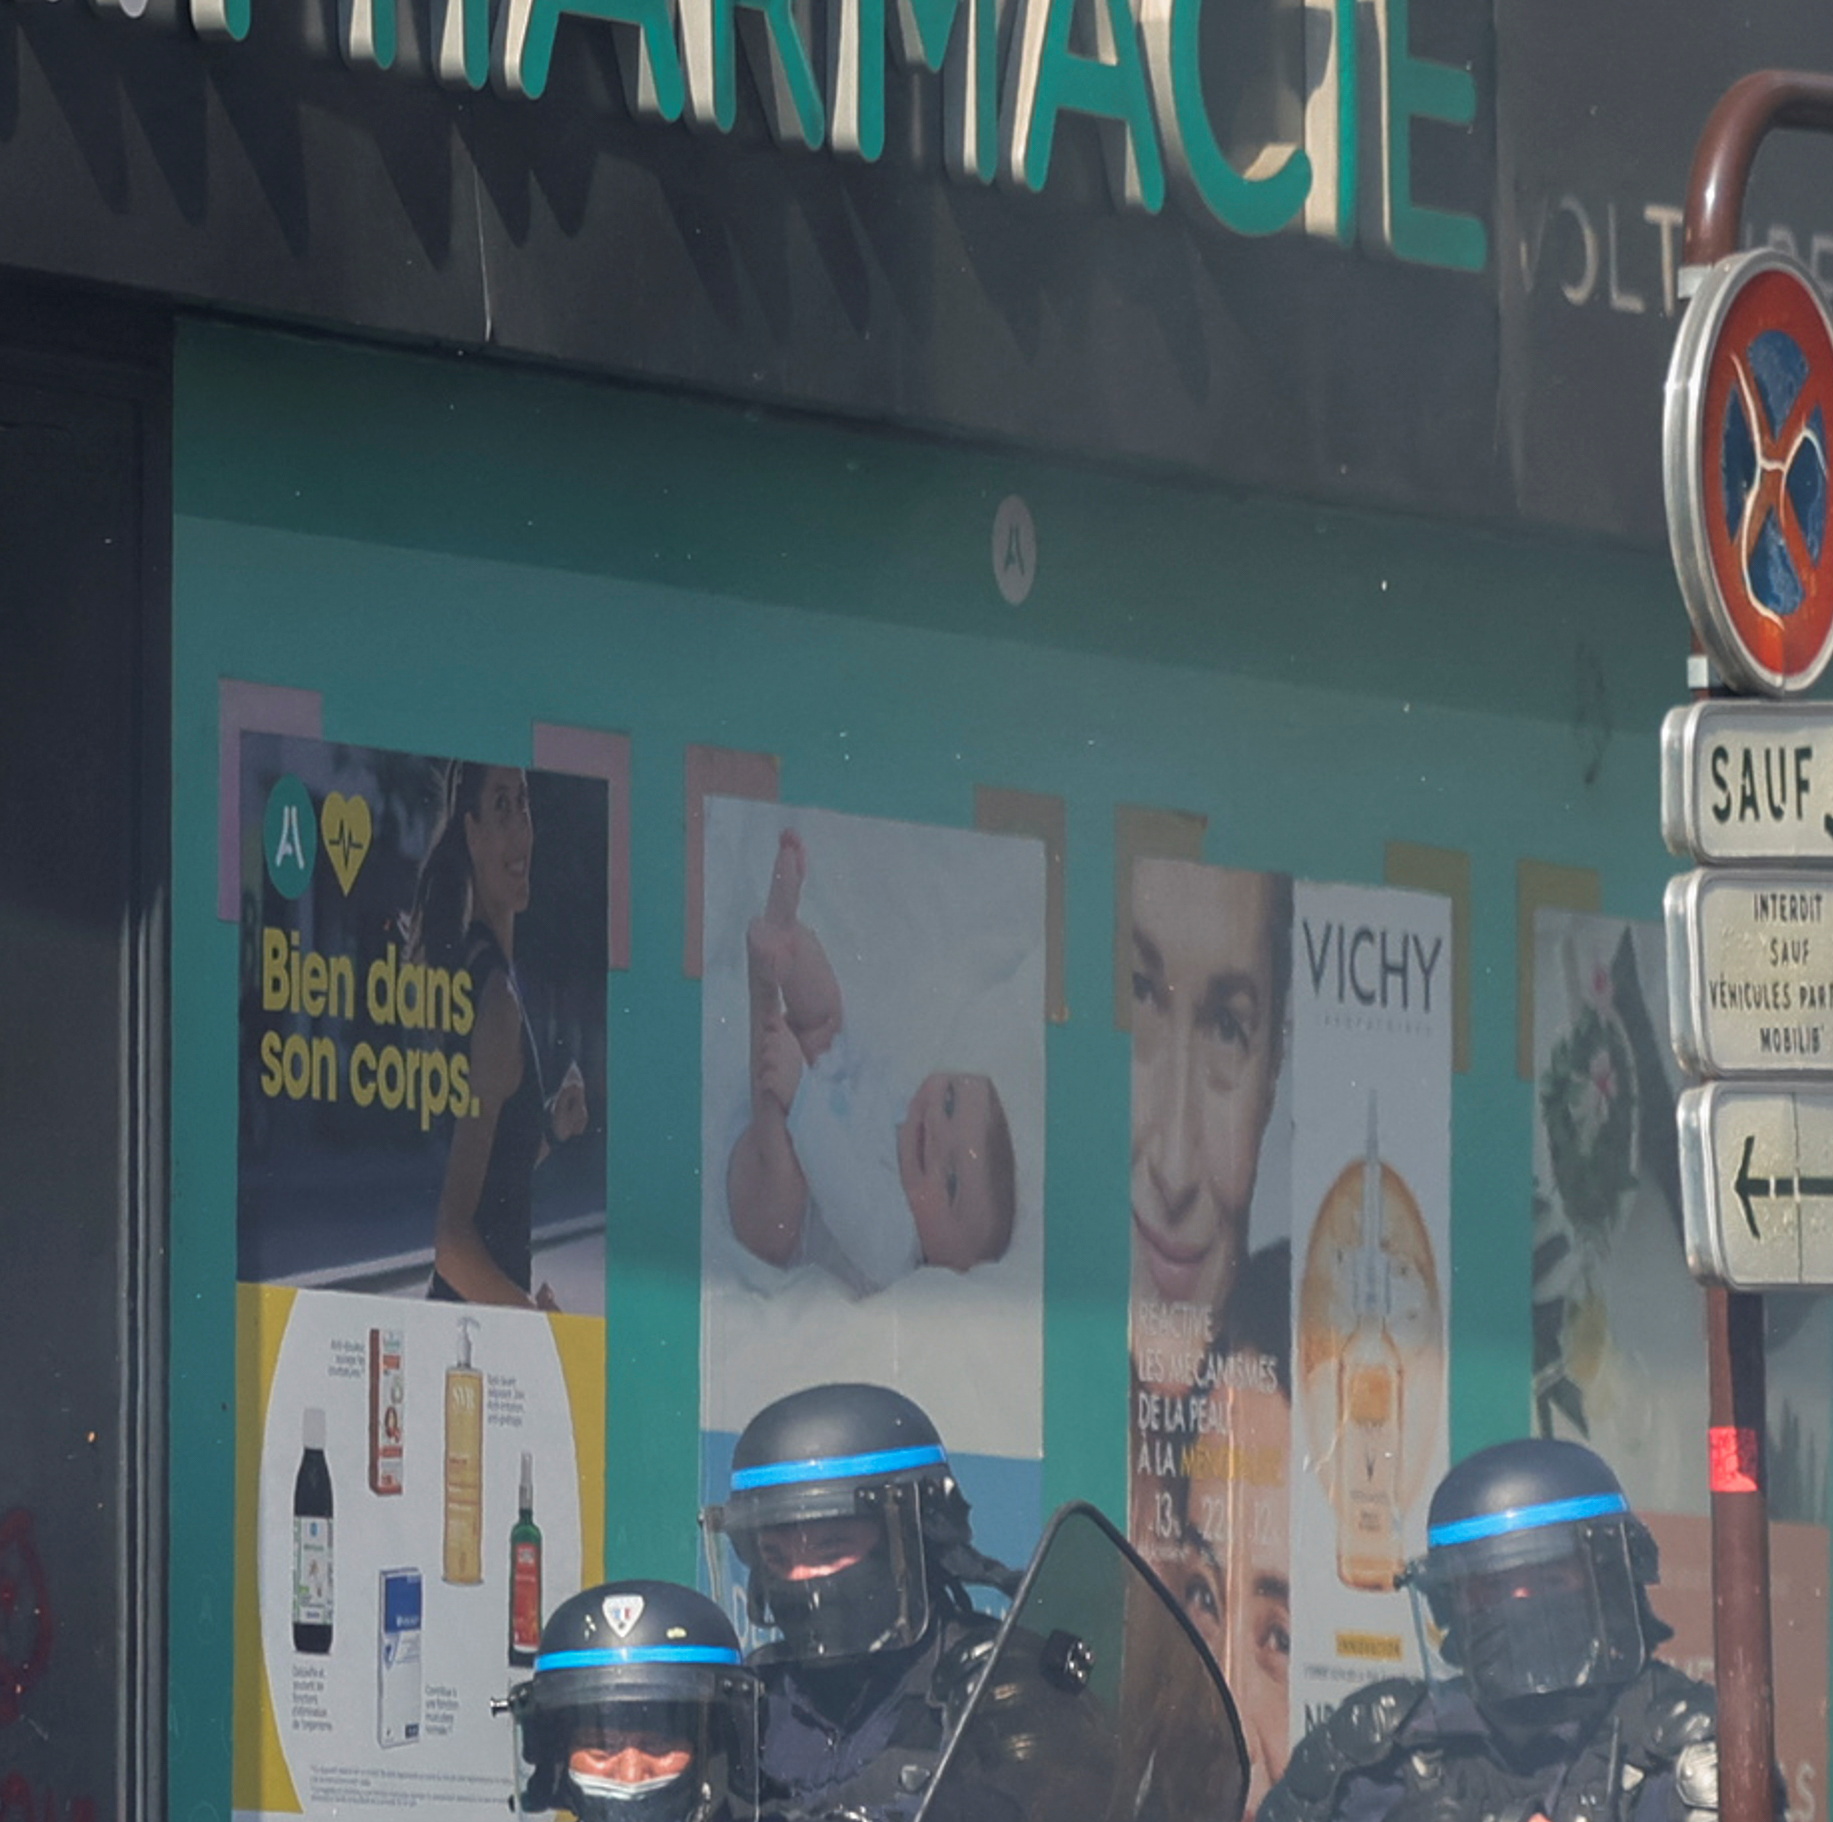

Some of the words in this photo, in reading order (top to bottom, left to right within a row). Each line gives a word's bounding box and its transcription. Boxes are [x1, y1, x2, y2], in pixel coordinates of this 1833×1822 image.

[222, 0, 1487, 271] MACIE
[1711, 745, 1813, 824] SAUF
[1753, 893, 1823, 923] INTERDIT
[263, 926, 354, 1021] Bien
[367, 942, 475, 1036] dans
[1302, 918, 1443, 1014] VICHY
[1769, 937, 1810, 967] SAUF
[1708, 972, 1792, 1011] VÉHICULES
[260, 1030, 337, 1102] son
[350, 1042, 480, 1132] corps.
[1137, 1391, 1160, 1431] DE
[1164, 1394, 1185, 1433] LA
[1155, 1438, 1176, 1478] LA
